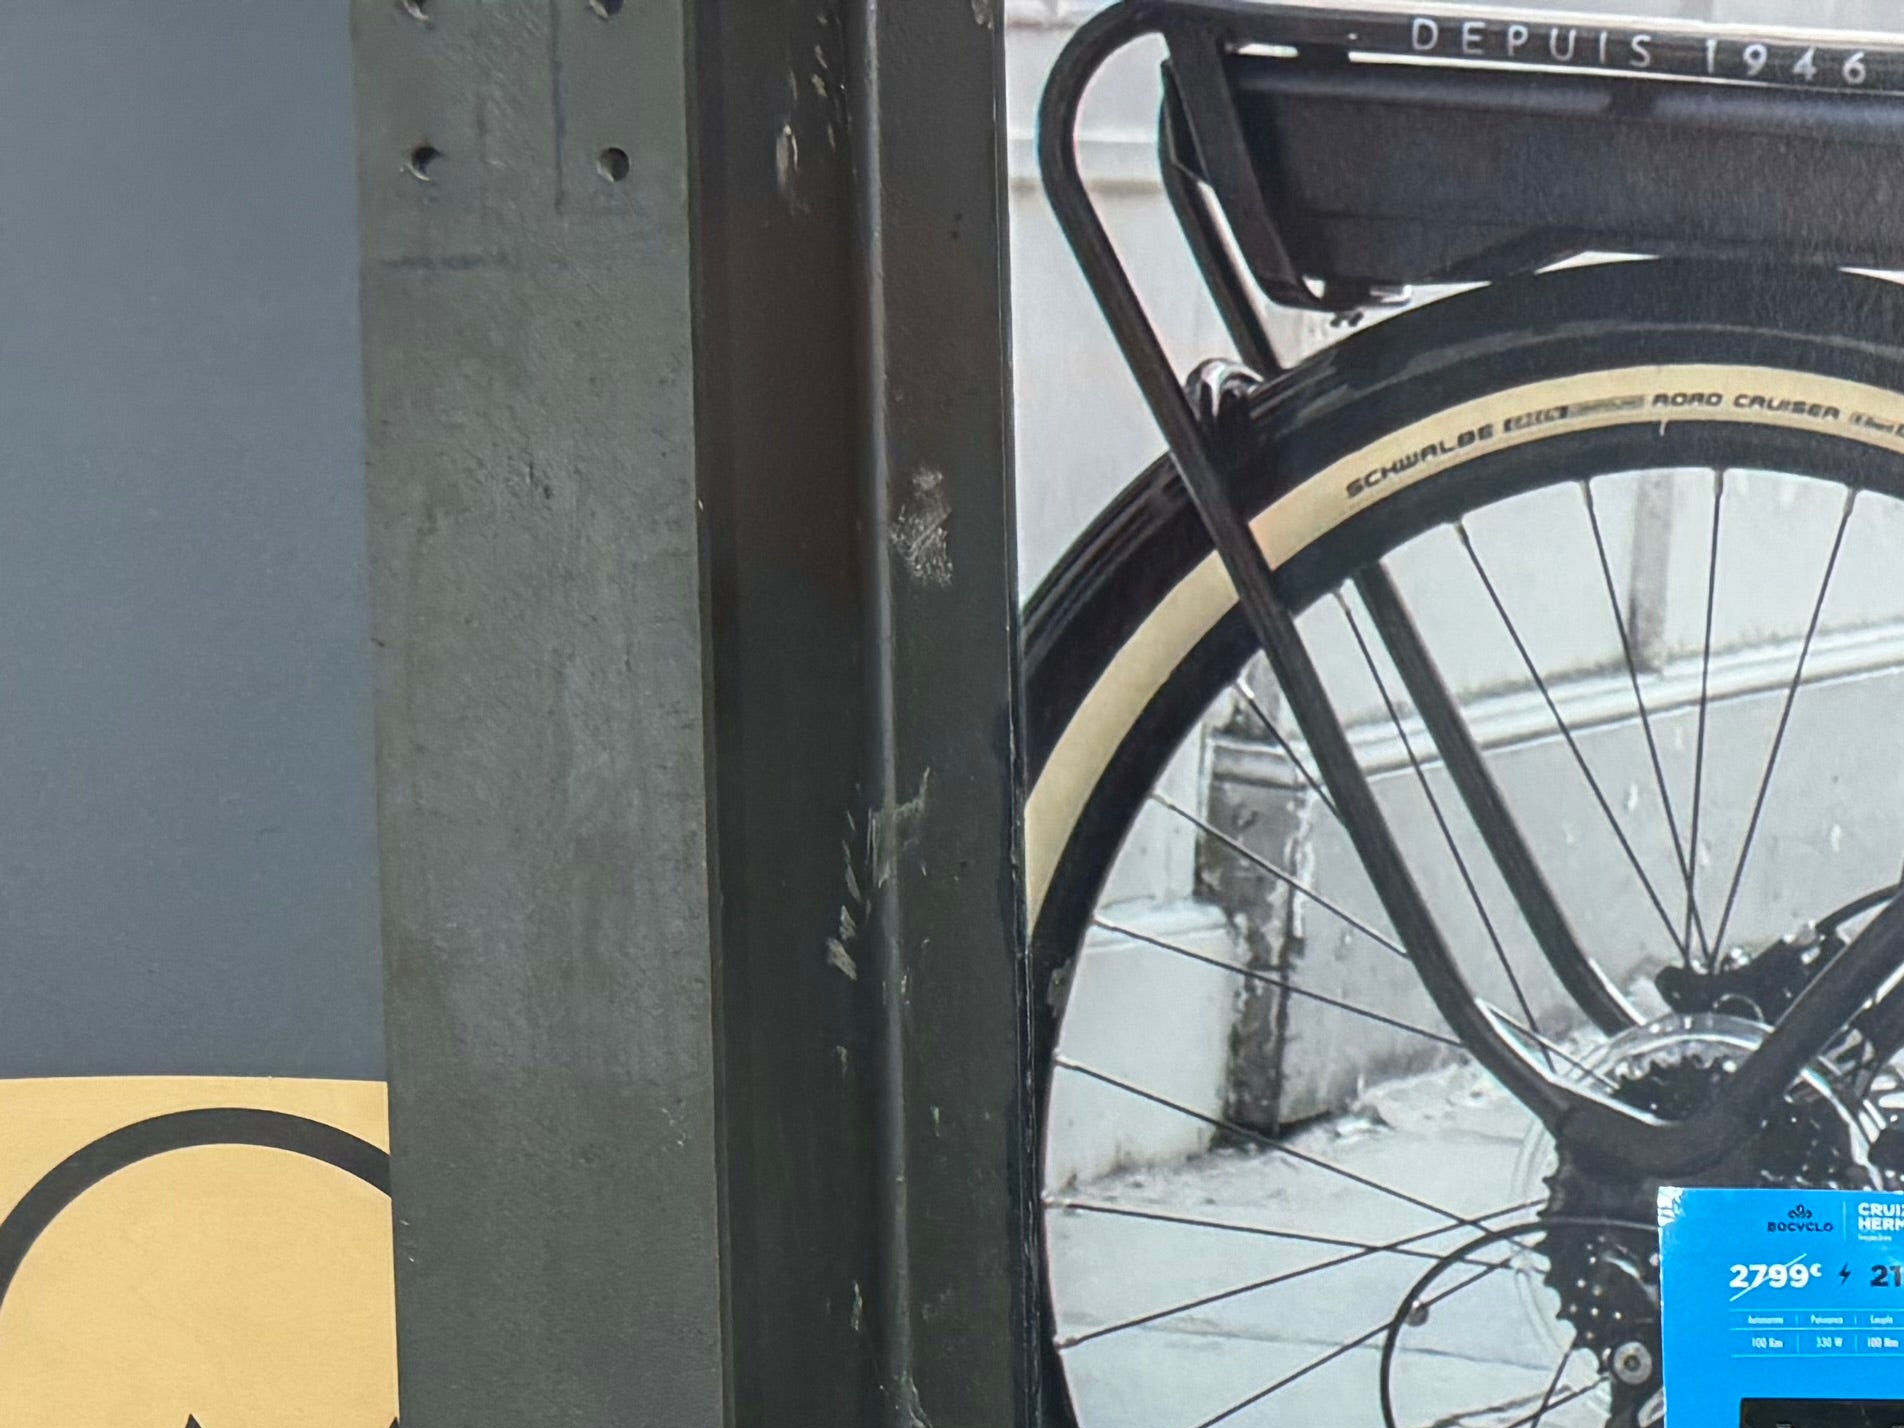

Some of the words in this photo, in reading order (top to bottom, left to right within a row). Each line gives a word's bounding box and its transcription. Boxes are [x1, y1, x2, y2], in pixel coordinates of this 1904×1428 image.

[1411, 17, 1651, 68] DEPUIS
[1704, 38, 1867, 85] 1946
[1651, 392, 1723, 408] ROAD
[1733, 393, 1841, 420] CRUISER
[1345, 423, 1494, 498] SCHWALBE
